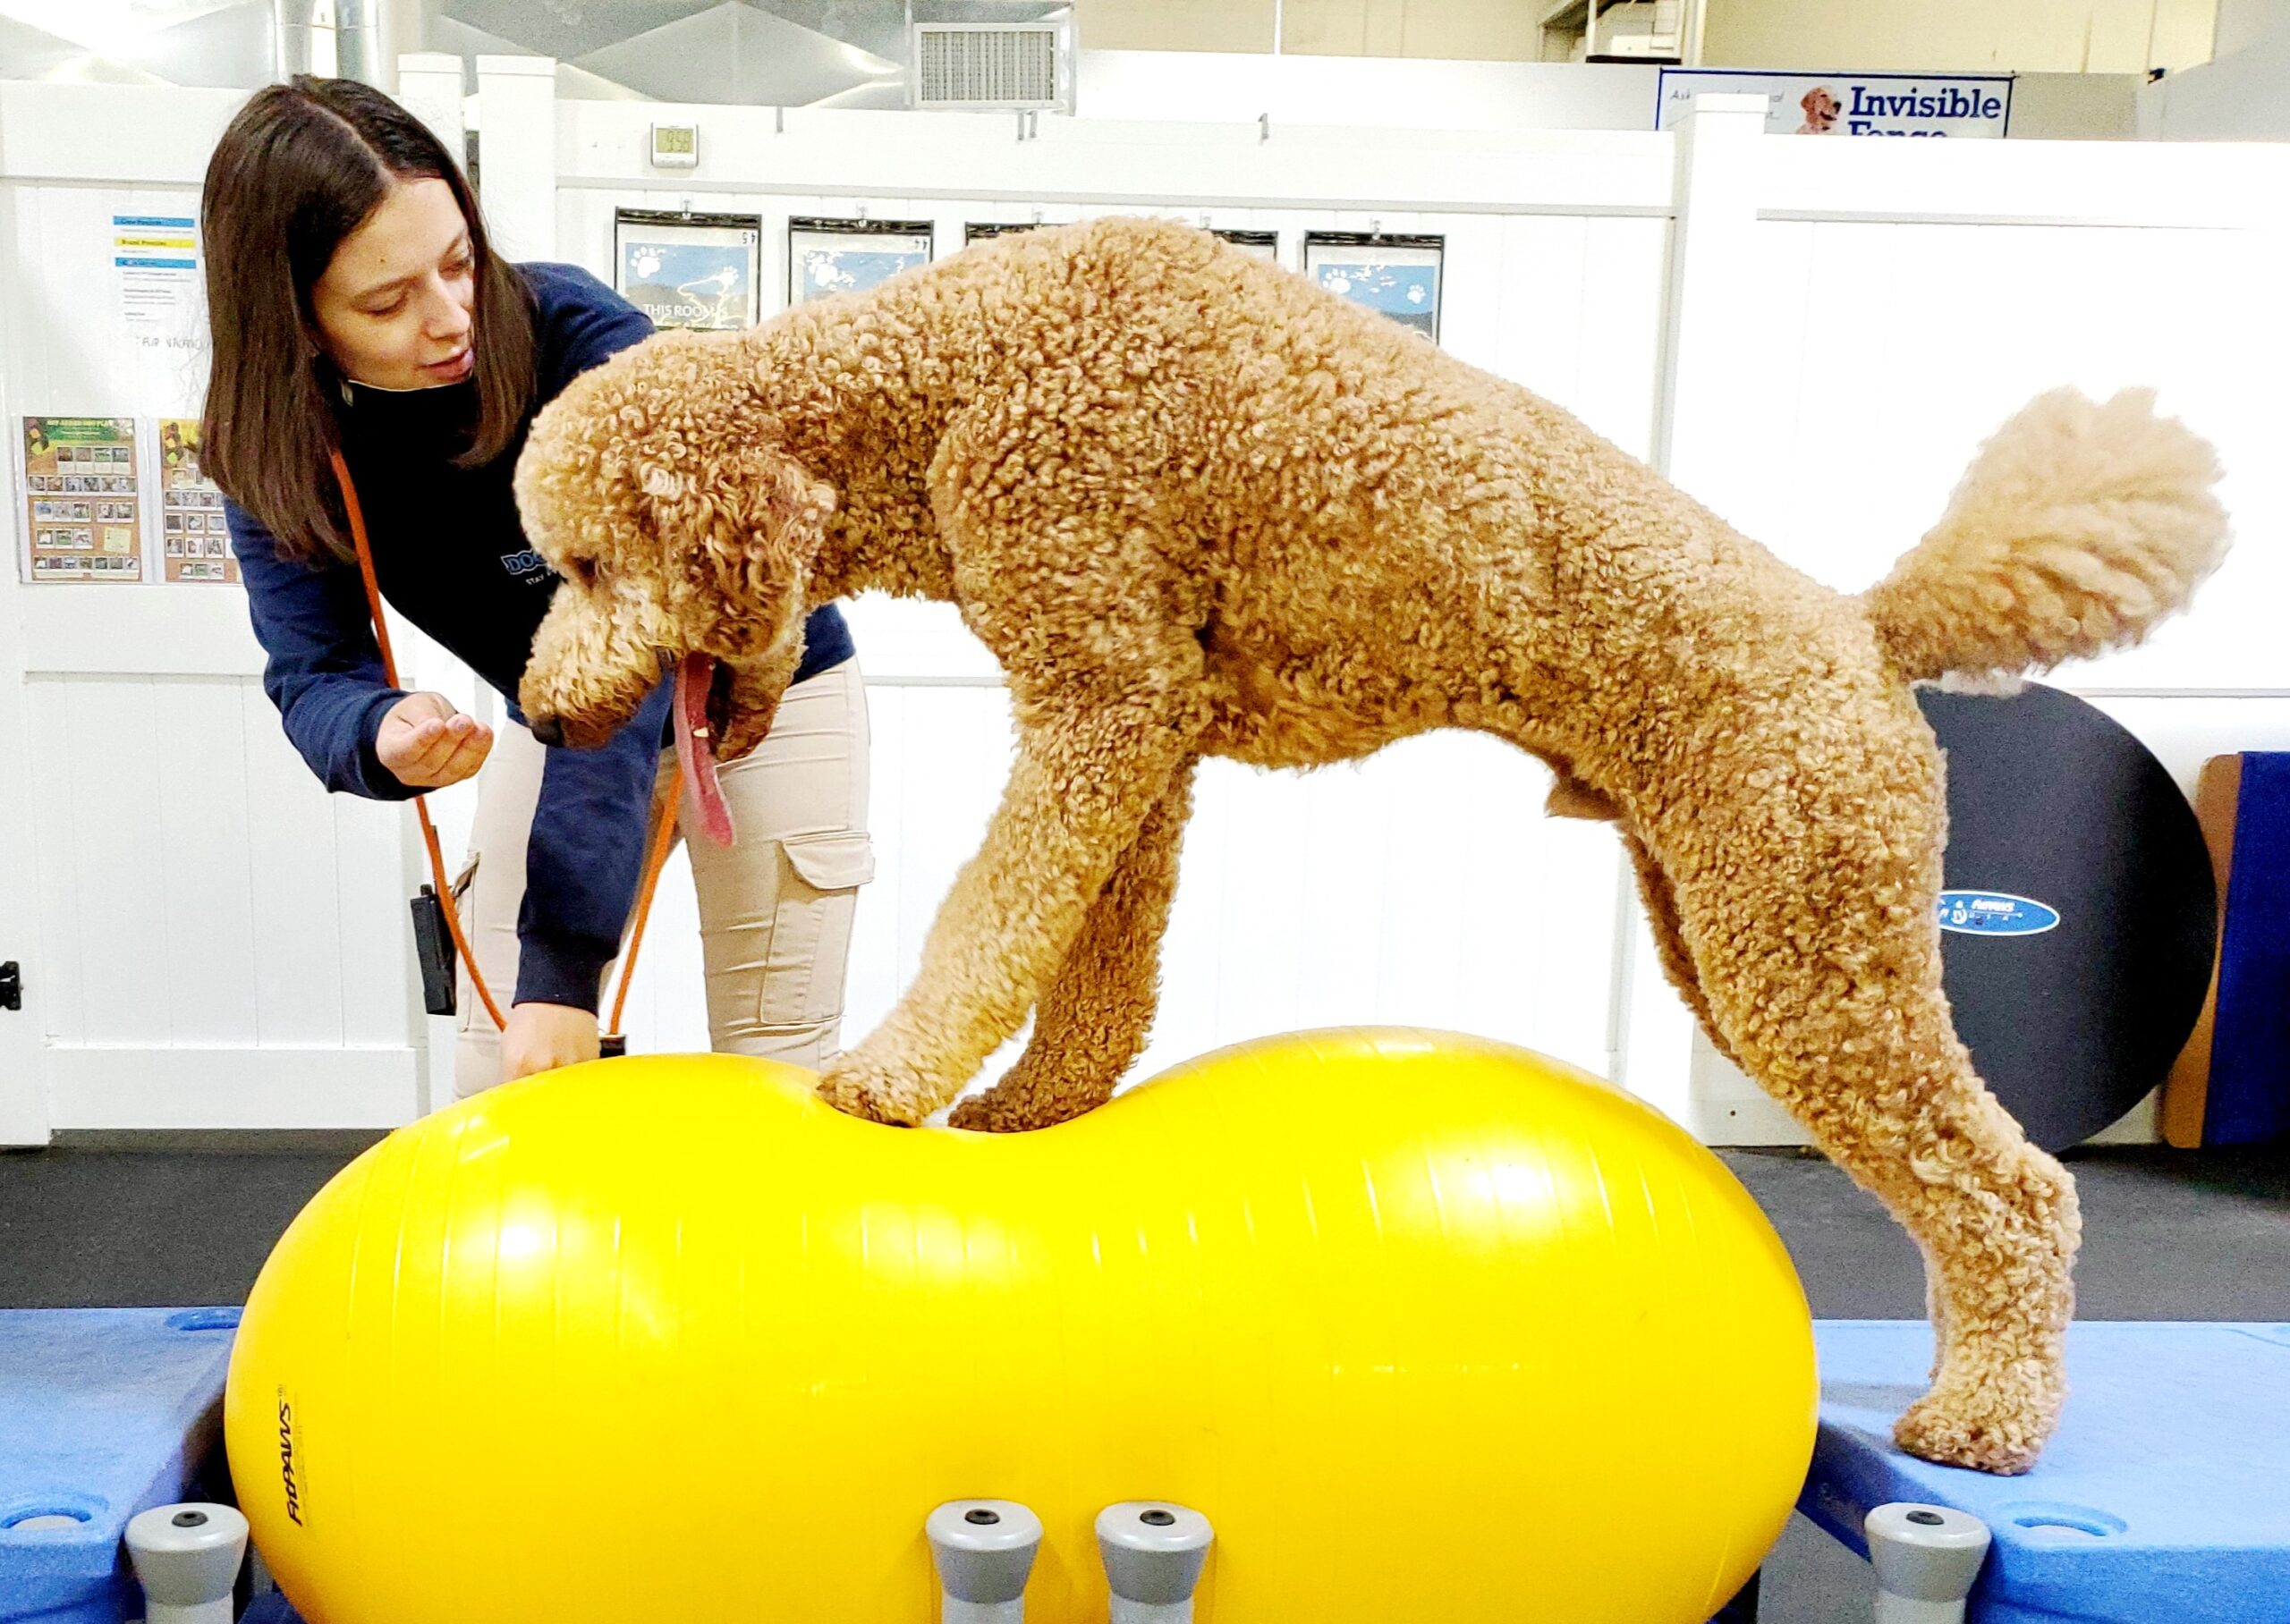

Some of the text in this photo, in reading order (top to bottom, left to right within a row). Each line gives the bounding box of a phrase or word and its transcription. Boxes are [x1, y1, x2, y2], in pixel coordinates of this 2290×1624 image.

[1848, 86, 2002, 119] Invisible
[642, 303, 673, 317] THIS
[525, 573, 545, 586] STAY
